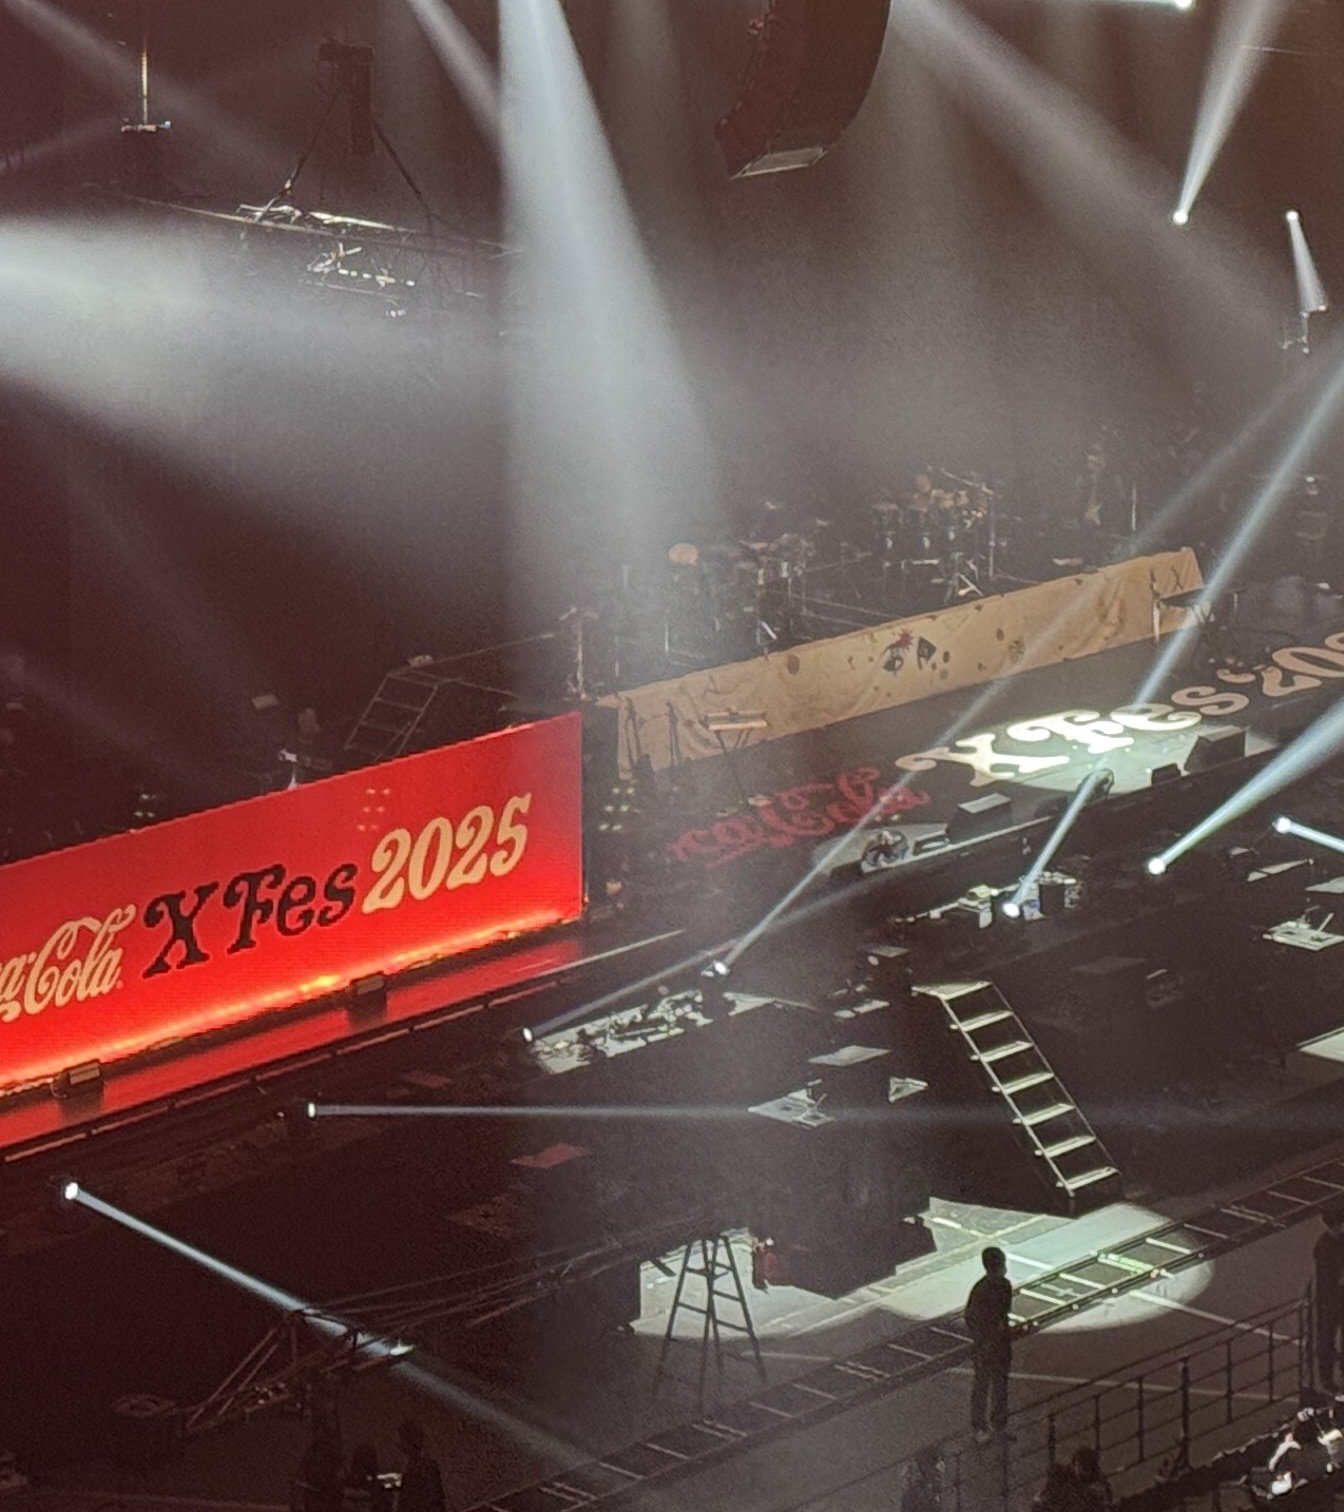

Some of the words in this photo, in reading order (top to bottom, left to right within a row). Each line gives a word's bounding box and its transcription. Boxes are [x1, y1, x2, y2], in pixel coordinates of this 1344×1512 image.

[894, 731, 1071, 788] X
[1006, 685, 1251, 755] Fes
[142, 880, 220, 979] X
[223, 863, 359, 956] Fes
[362, 792, 532, 914] 2025
